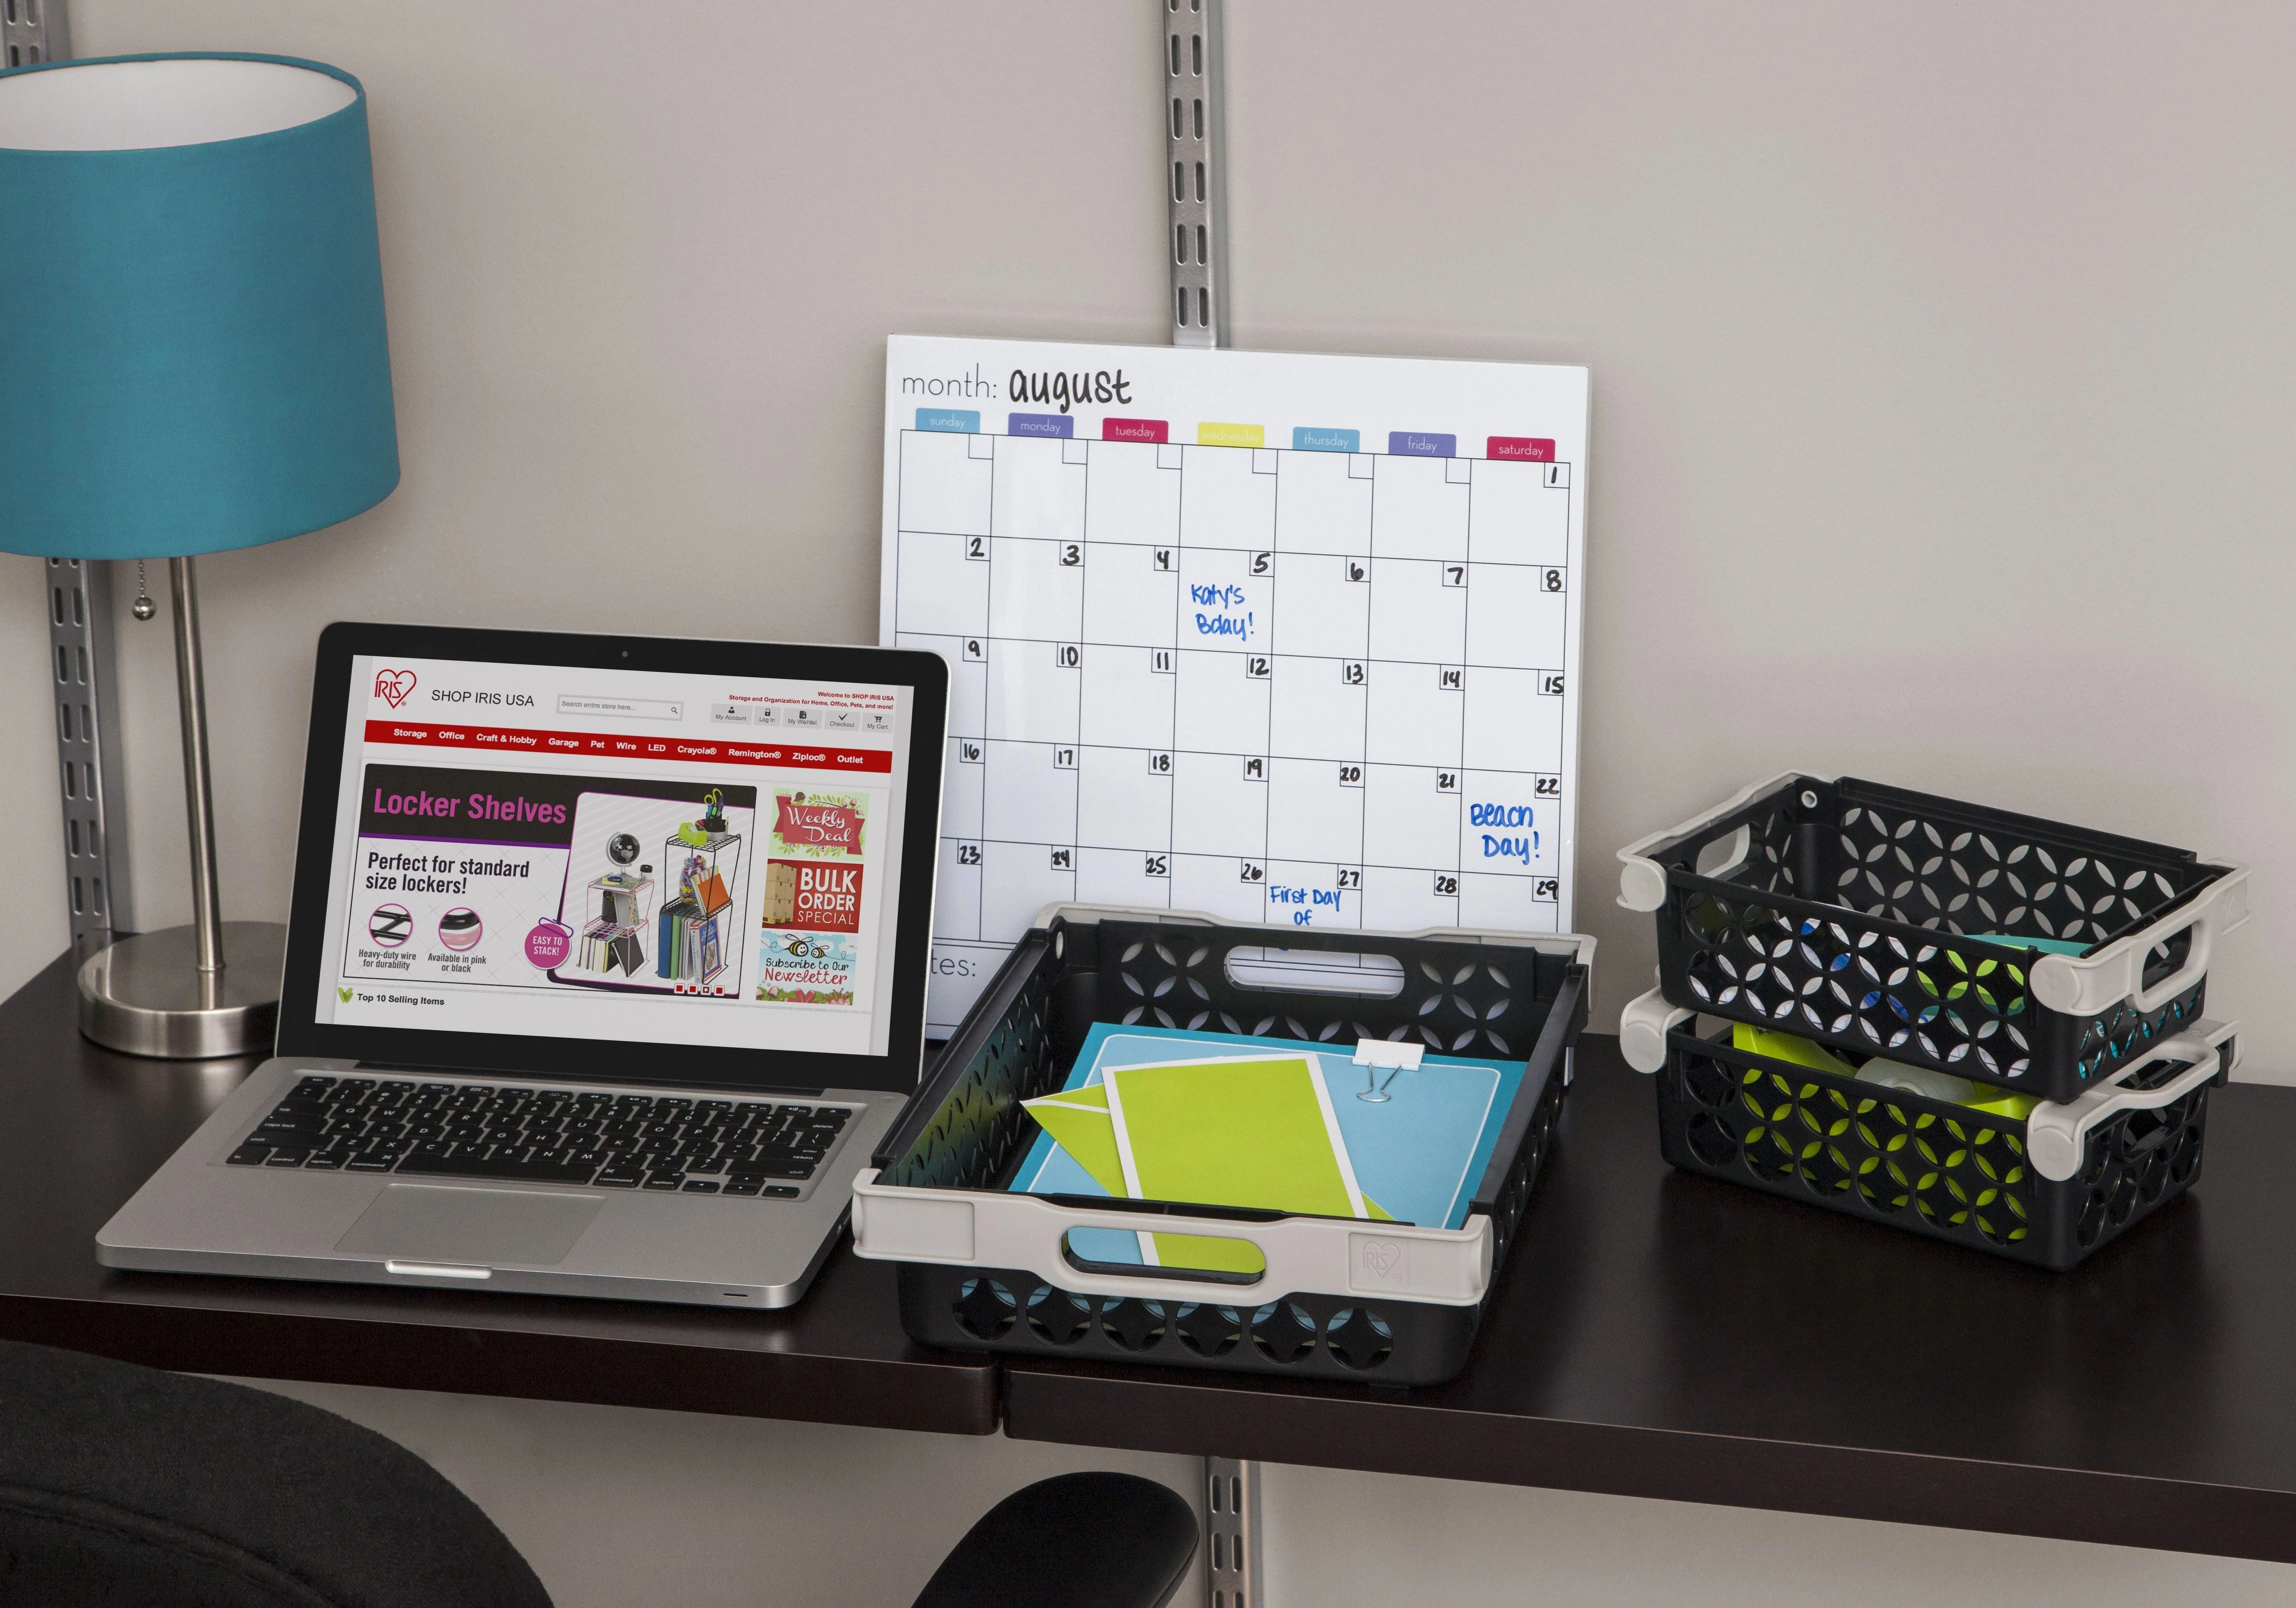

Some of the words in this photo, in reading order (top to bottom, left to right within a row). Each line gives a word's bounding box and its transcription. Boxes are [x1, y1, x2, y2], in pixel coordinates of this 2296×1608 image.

[903, 363, 996, 398] month:
[1010, 370, 1132, 414] august
[929, 416, 965, 430] sunday
[1021, 421, 1060, 434] monday
[1115, 426, 1155, 439] tuesday
[1202, 428, 1259, 444] wednesday
[1304, 431, 1349, 449] thursday
[1408, 436, 1437, 453] friday
[1499, 442, 1543, 458] saturday
[1551, 466, 1557, 484] 1
[970, 537, 984, 557] 2
[1063, 545, 1080, 565] 3
[1157, 550, 1170, 569] 4
[1253, 553, 1270, 573] 5
[1351, 563, 1364, 581] 6
[1447, 567, 1463, 585] 7
[1547, 570, 1562, 592] 8
[1191, 584, 1245, 609] Katy's
[1195, 612, 1254, 641] Bday!
[968, 641, 980, 657] 9
[1061, 647, 1078, 666] 10
[1157, 652, 1169, 670] 11
[1250, 658, 1269, 675] 12
[1346, 664, 1364, 684] 13
[1443, 671, 1460, 688] 14
[375, 680, 402, 698] IRIS
[1546, 677, 1564, 694] 15
[432, 690, 471, 702] SHOP
[475, 693, 501, 704] IRIS
[506, 694, 534, 706] USA
[394, 729, 427, 739] Storage
[439, 732, 465, 740] Office
[510, 736, 537, 745] Hobby
[549, 738, 579, 748] Garage
[837, 755, 863, 763] Outlet
[964, 743, 979, 760] 16
[1059, 749, 1073, 765] 17
[1153, 754, 1170, 771] 18
[1248, 759, 1262, 778] 19
[1340, 767, 1360, 782] 20
[1439, 774, 1454, 789] 21
[1536, 778, 1559, 794] 22
[374, 789, 460, 817] Locker
[468, 794, 566, 824] Shelves
[787, 806, 845, 828] Weekly
[802, 826, 851, 841] Deal
[959, 845, 980, 863] 23
[1482, 831, 1539, 865] Day!
[368, 852, 427, 872] Perfect
[432, 856, 455, 873] for
[460, 859, 529, 877] standard
[1052, 849, 1069, 867] 24
[1146, 856, 1166, 875] 25
[801, 868, 858, 893] BULK
[1242, 863, 1262, 880] 26
[1339, 871, 1359, 888] 27
[366, 872, 396, 890] size
[402, 874, 466, 893] lockers!
[1435, 876, 1456, 893] 28
[1536, 880, 1558, 900] 29
[798, 892, 855, 911] ORDER
[1270, 886, 1307, 903] First
[1313, 889, 1341, 912] Day
[798, 911, 854, 924] SPECIAL
[533, 936, 551, 945] EASY
[358, 950, 396, 961] Heavy-duty
[397, 952, 416, 962] wire
[428, 953, 459, 962] Available
[461, 955, 469, 963] in
[471, 956, 487, 966] pink
[534, 946, 559, 955] STACK!
[363, 959, 374, 967] for
[376, 960, 410, 971] durability
[452, 964, 471, 972] black
[766, 958, 815, 970] Subscribe
[819, 961, 828, 970] to
[832, 962, 849, 971] Our
[931, 949, 976, 976] tes:
[765, 968, 847, 984] Newsletter
[357, 994, 373, 1002] Top
[388, 995, 418, 1005] Selling
